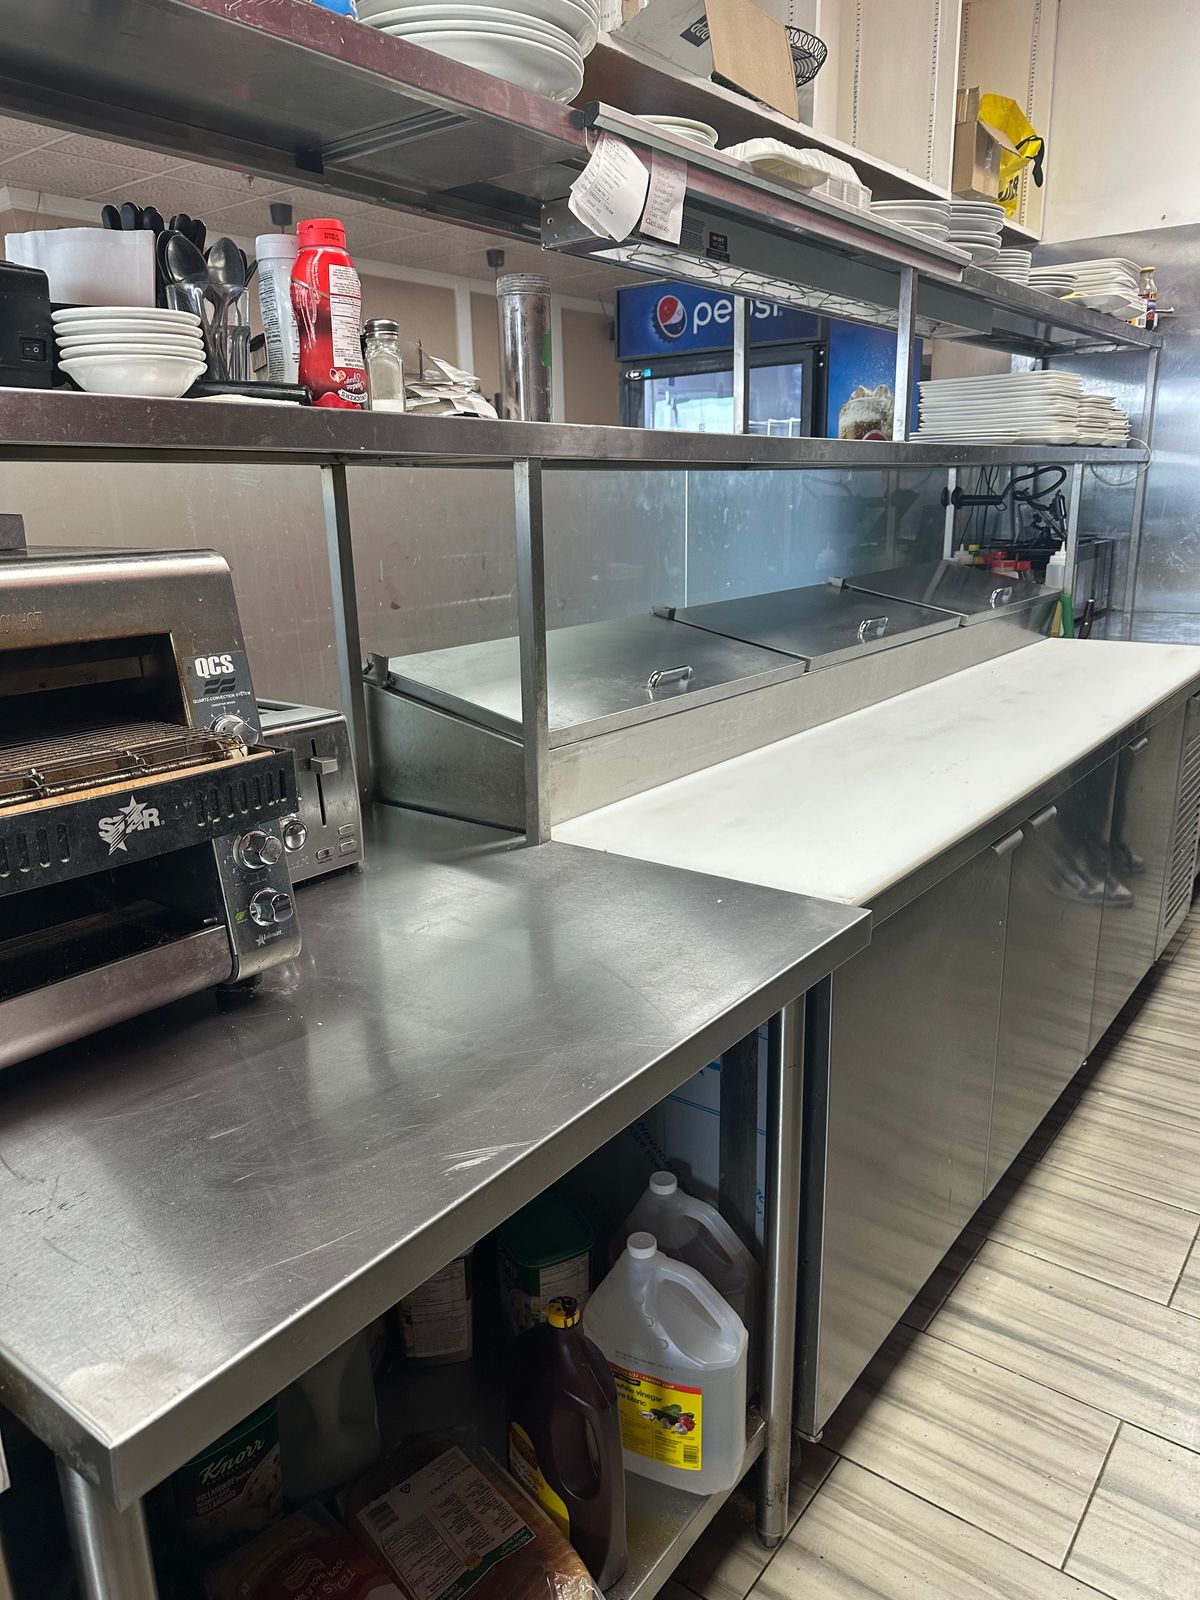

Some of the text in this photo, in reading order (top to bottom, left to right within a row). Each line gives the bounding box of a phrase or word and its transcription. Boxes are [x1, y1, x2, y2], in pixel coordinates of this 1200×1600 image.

[693, 298, 779, 335] pesi
[195, 654, 234, 678] QCS
[98, 807, 161, 841] STAR
[627, 1393, 647, 1407] blanc
[635, 1389, 663, 1403] vinegar
[199, 1439, 265, 1485] Knorr
